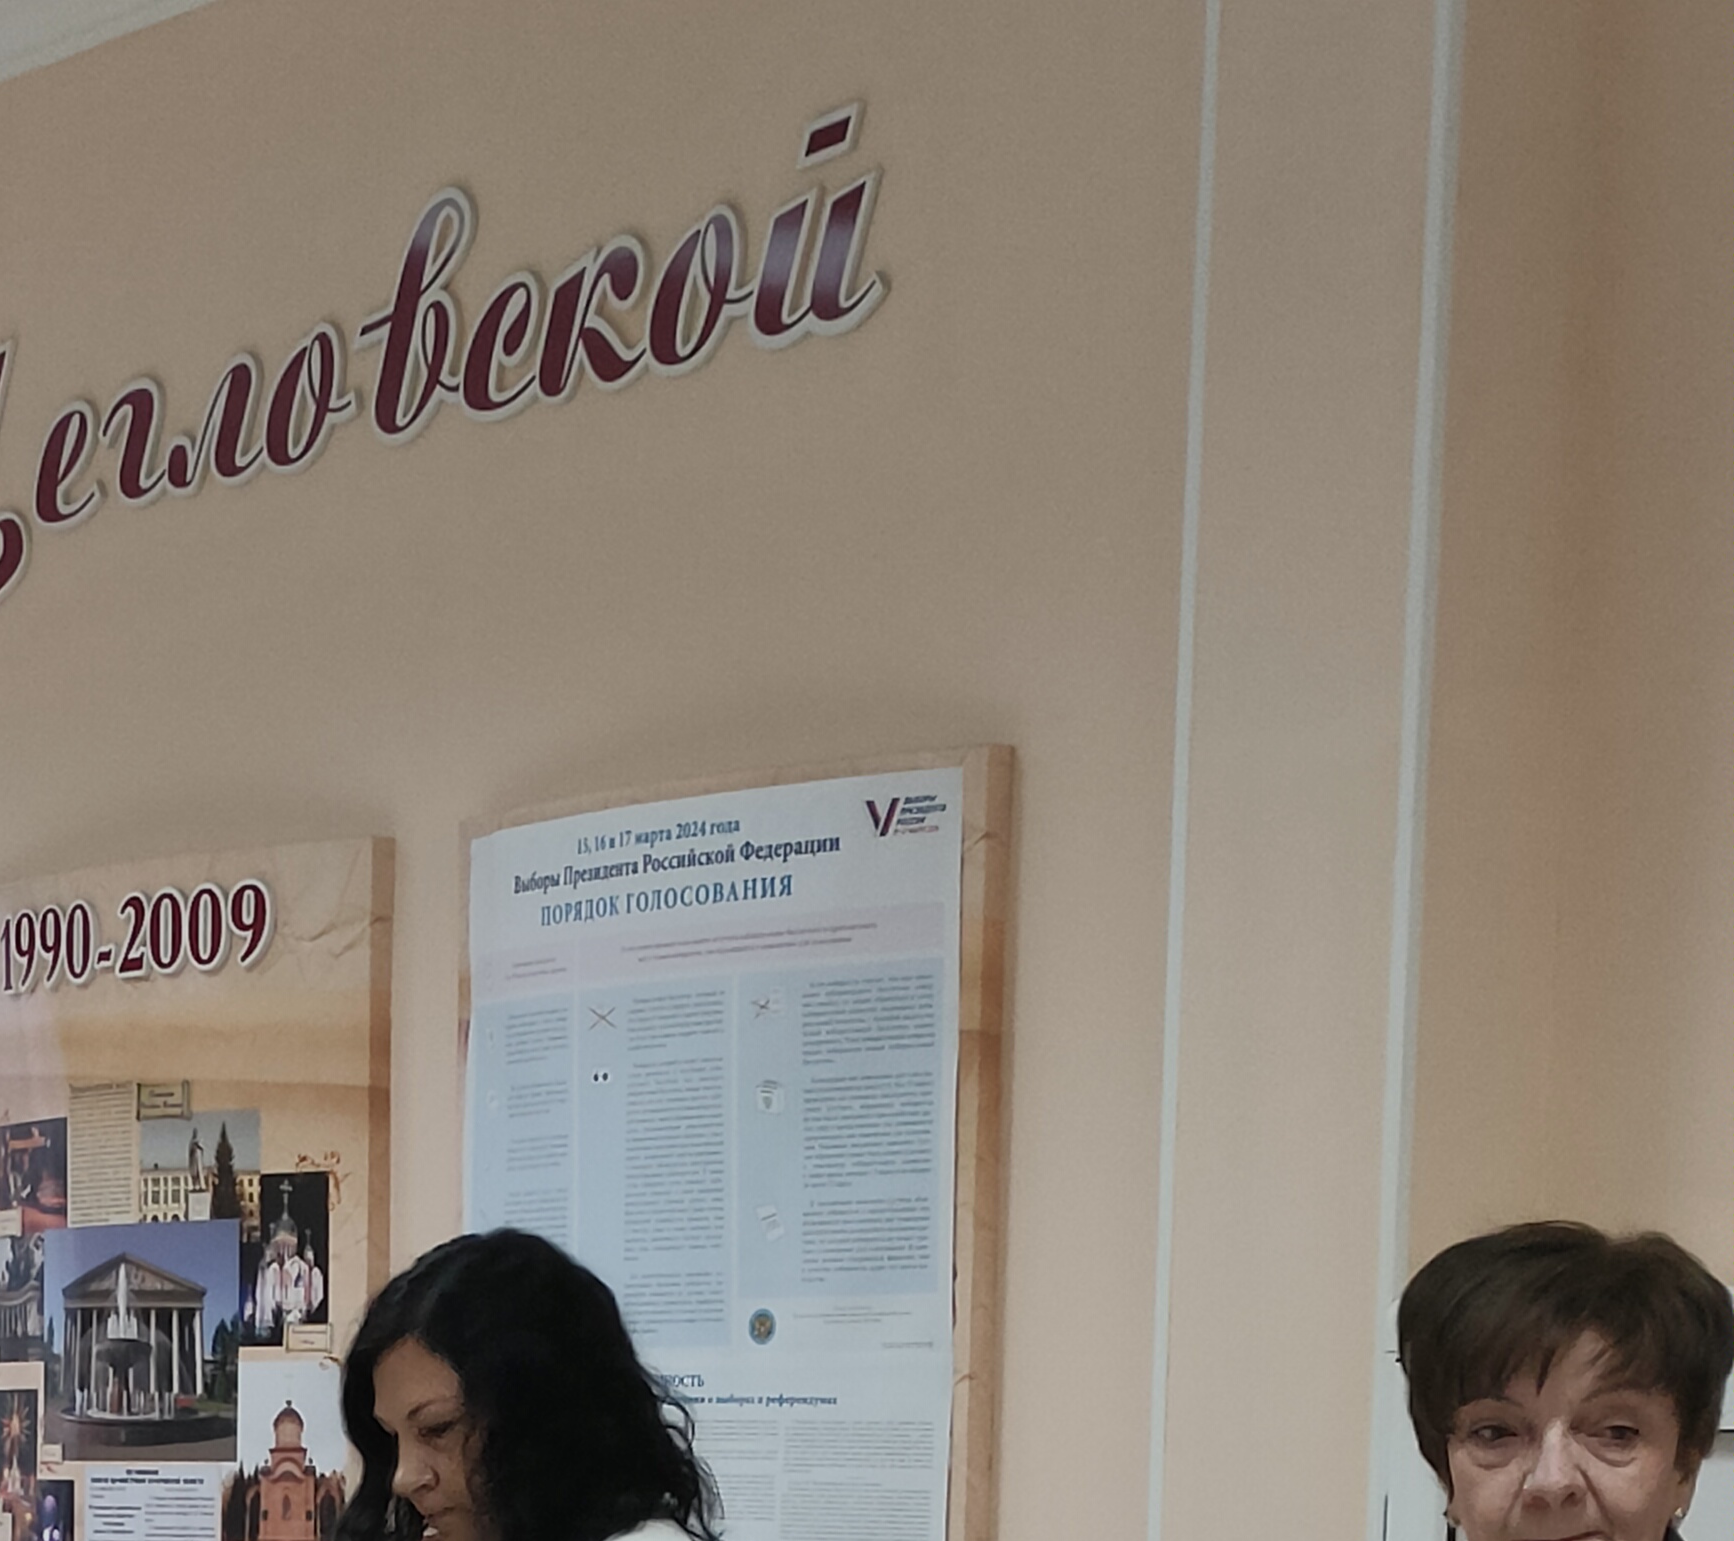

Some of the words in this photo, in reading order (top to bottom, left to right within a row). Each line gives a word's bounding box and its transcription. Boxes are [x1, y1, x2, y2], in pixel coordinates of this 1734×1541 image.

[577, 838, 592, 855] 15,
[594, 835, 607, 852] 16
[609, 836, 616, 848] и
[619, 830, 633, 847] 17
[634, 828, 672, 848] марта
[675, 820, 707, 840] 2024
[709, 819, 741, 835] года
[514, 871, 561, 894] Выборы
[563, 861, 638, 889] Президента
[642, 843, 735, 874] Российской
[739, 836, 841, 863] Федерации
[541, 895, 620, 927] ПОРЯДОК
[626, 874, 793, 914] ГОЛОСОВАНИЯ
[0, 882, 269, 993] 1990-2009
